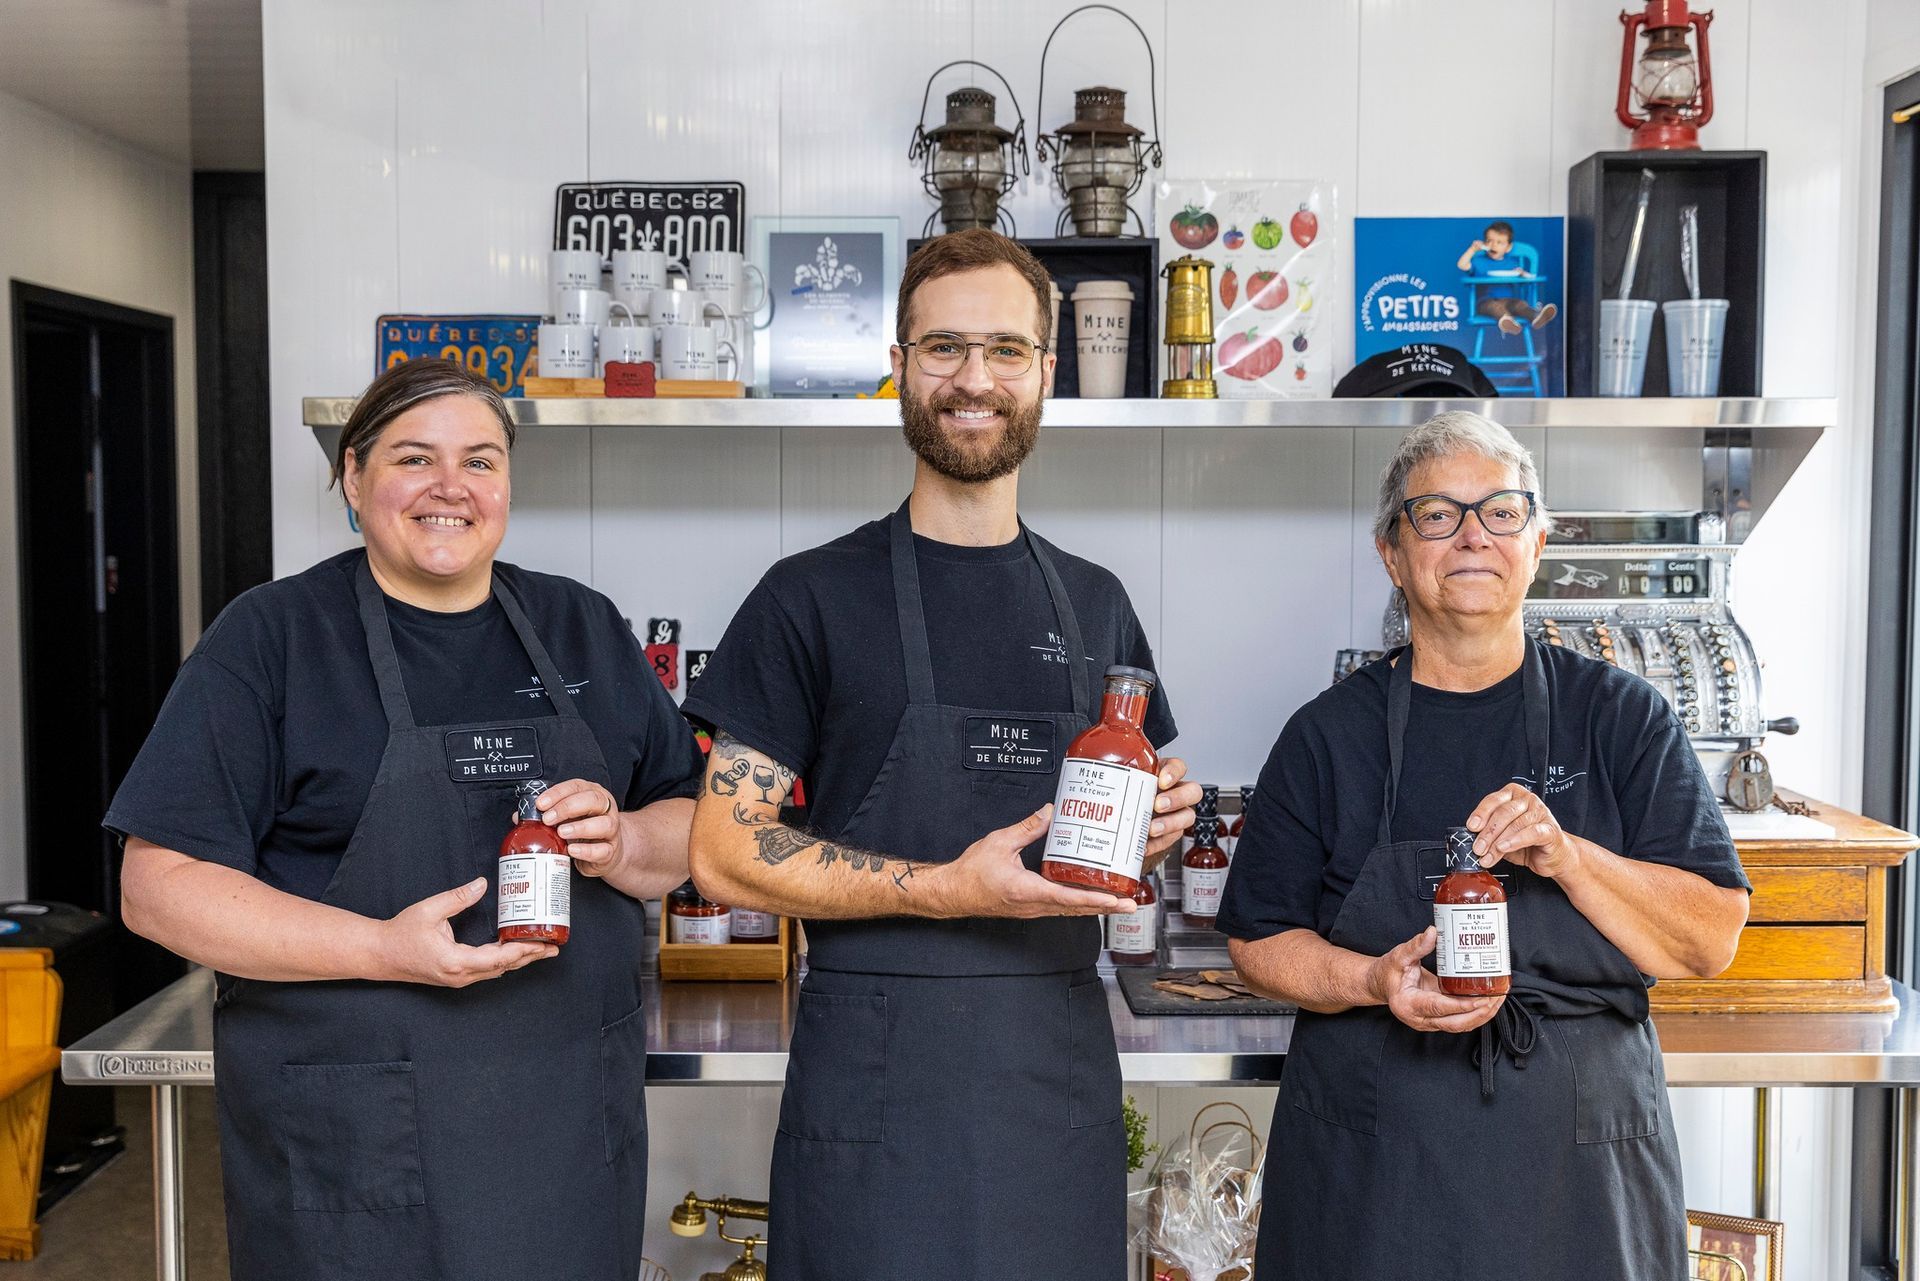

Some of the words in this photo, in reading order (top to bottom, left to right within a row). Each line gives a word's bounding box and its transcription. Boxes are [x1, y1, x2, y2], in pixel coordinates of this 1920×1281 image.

[567, 213, 634, 260] 603
[664, 214, 731, 261] 800
[1378, 295, 1459, 319] PETITS
[1084, 314, 1125, 329] MINE
[1382, 320, 1459, 332] AMBASSADEURS
[1402, 345, 1439, 355] MINE
[1392, 366, 1404, 377] DE
[1411, 363, 1452, 376] KETCHUP
[1624, 562, 1656, 571] Dollars
[1668, 562, 1695, 571] Cents
[655, 655, 669, 676] 8
[990, 724, 1030, 740] MINE
[473, 736, 514, 750] MINE
[976, 753, 990, 763] DE
[997, 753, 1042, 766] KETCHUP
[464, 765, 477, 775] DE
[484, 763, 530, 774] KETCHUP
[1078, 767, 1105, 780] MINE
[1080, 787, 1111, 797] KETCHUP
[1060, 798, 1114, 823] KETCHUP
[500, 881, 530, 897] KETCHUP
[1193, 887, 1218, 896] KETCHUP
[1116, 923, 1142, 933] KETCHUP
[1459, 933, 1496, 945] KETCHUP
